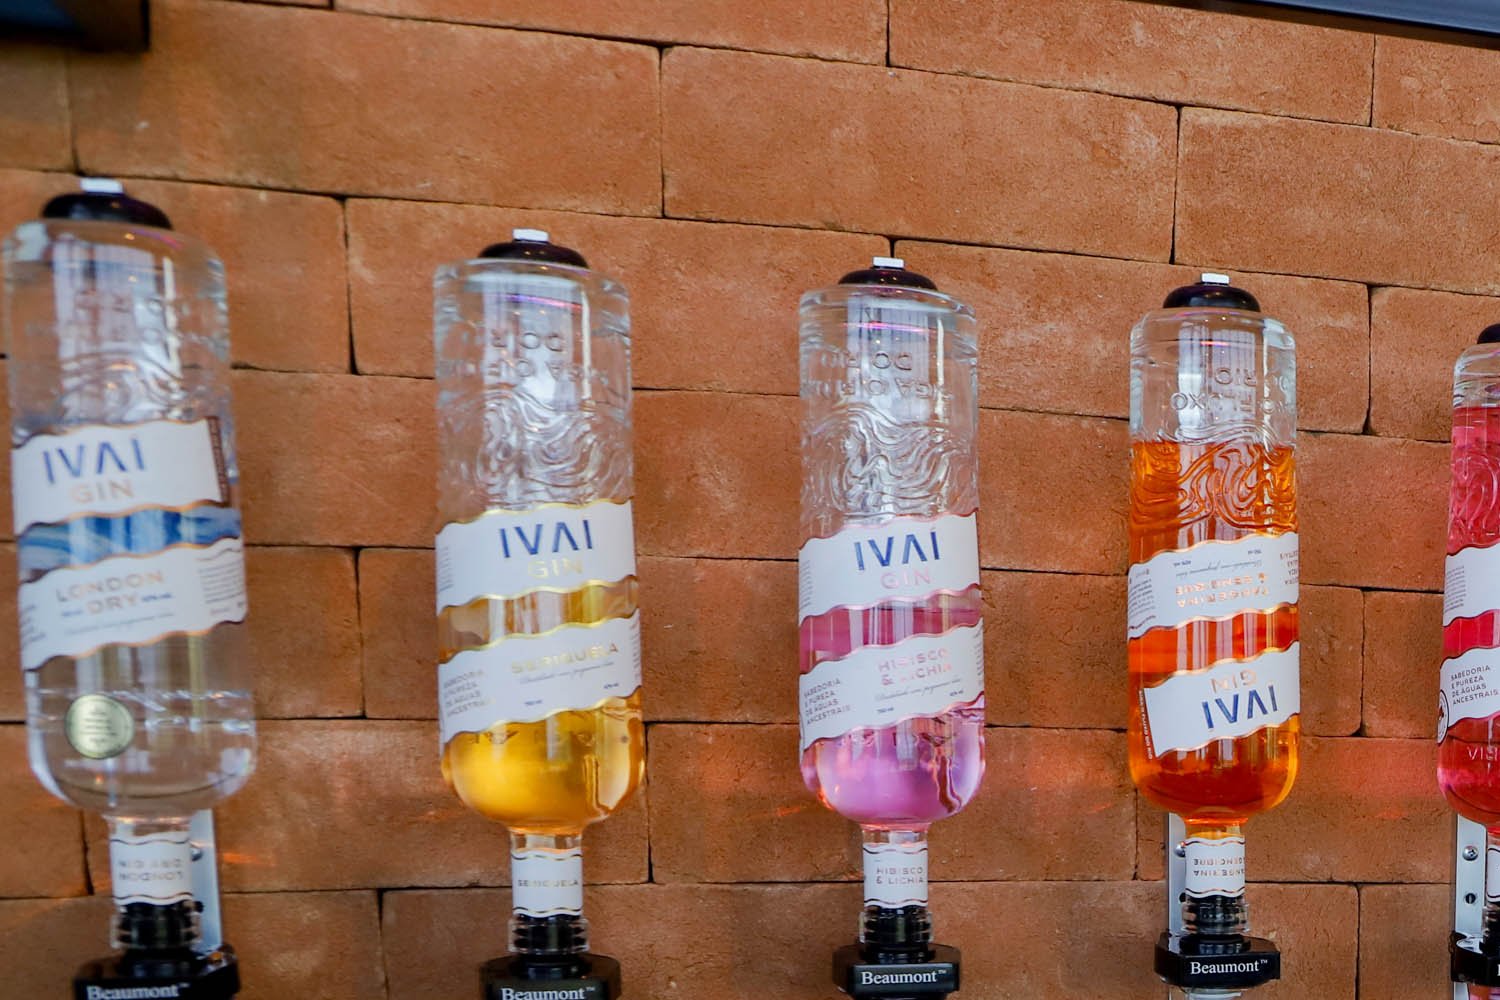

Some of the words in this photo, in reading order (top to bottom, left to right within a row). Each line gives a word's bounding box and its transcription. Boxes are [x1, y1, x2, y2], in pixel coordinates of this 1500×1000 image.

[71, 479, 135, 504] GIN
[527, 557, 583, 579] GIN
[880, 568, 932, 590] GIN
[56, 570, 165, 602] LONDON
[1210, 668, 1257, 694] GIN
[1451, 665, 1491, 681] SABEDORIA
[1456, 675, 1484, 687] PUREZA
[1453, 689, 1500, 705] ANCESTRAIS
